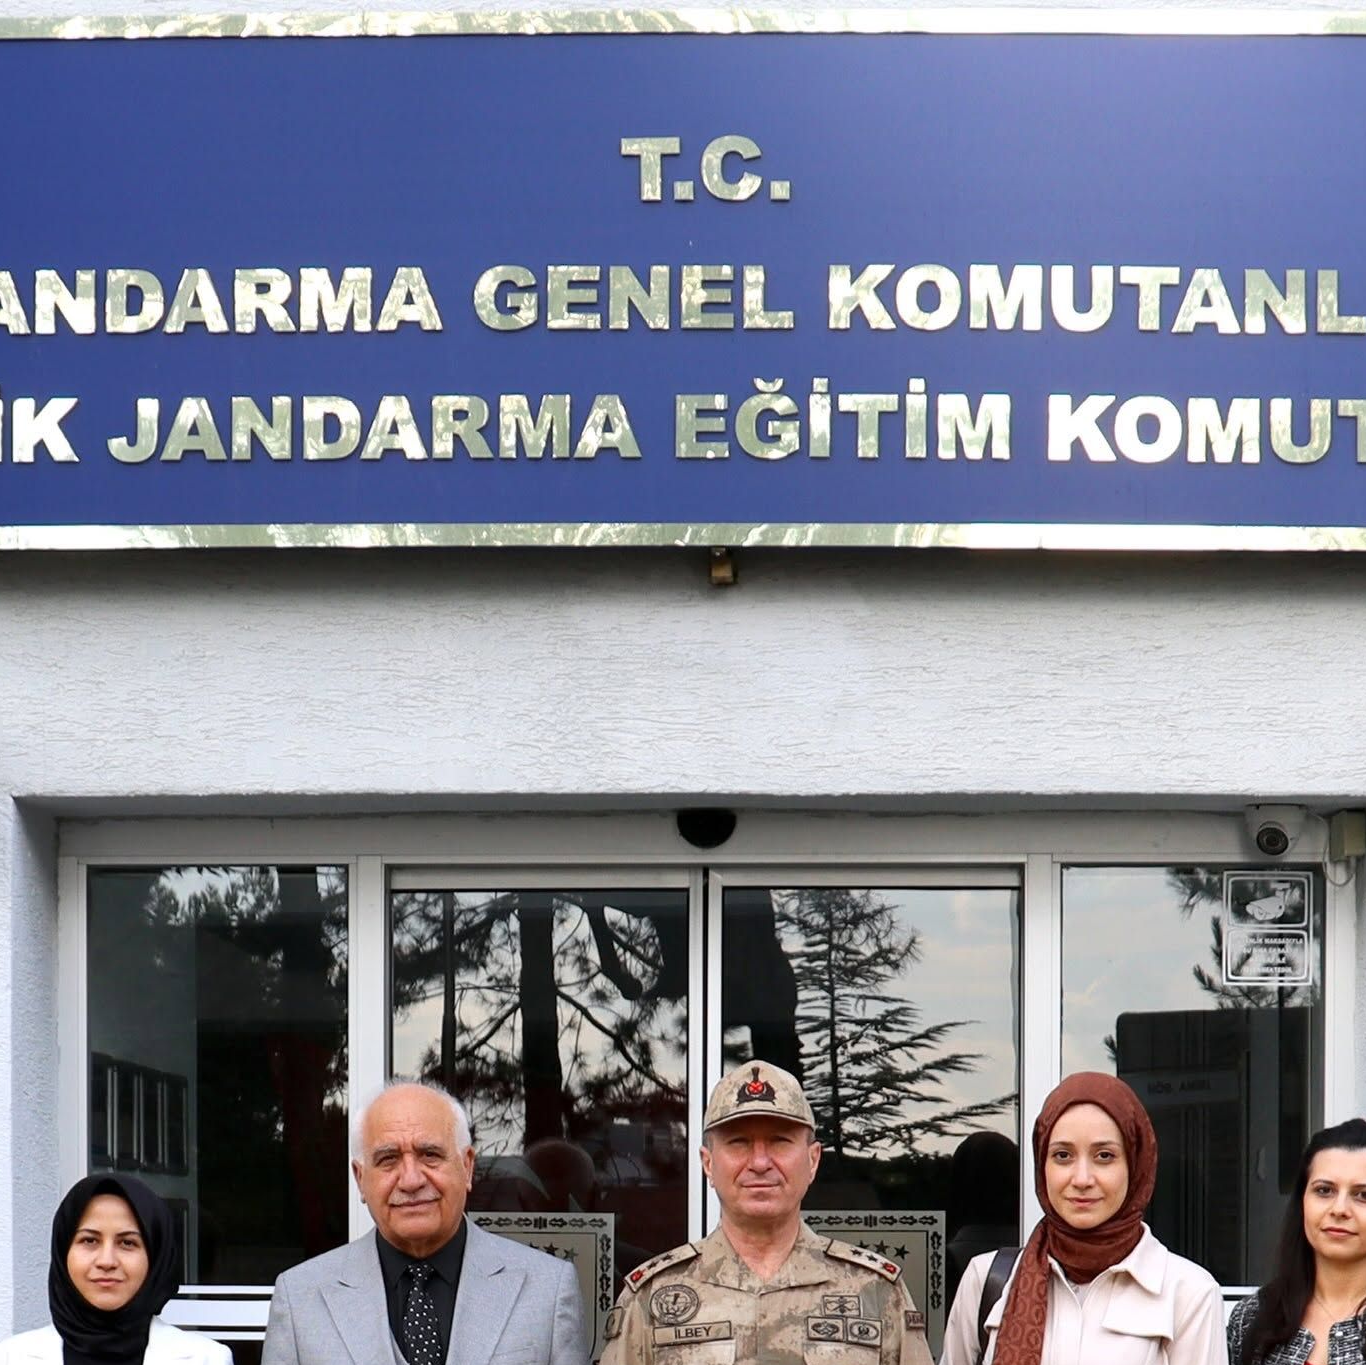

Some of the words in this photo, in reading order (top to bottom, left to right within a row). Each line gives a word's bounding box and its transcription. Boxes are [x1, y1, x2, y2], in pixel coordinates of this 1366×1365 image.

[619, 134, 793, 205] T.C.
[472, 263, 795, 334] GENEL
[106, 393, 643, 466] JANDARMA
[674, 377, 1016, 464] EĞİTİM
[674, 1325, 712, 1340] İLBEY
